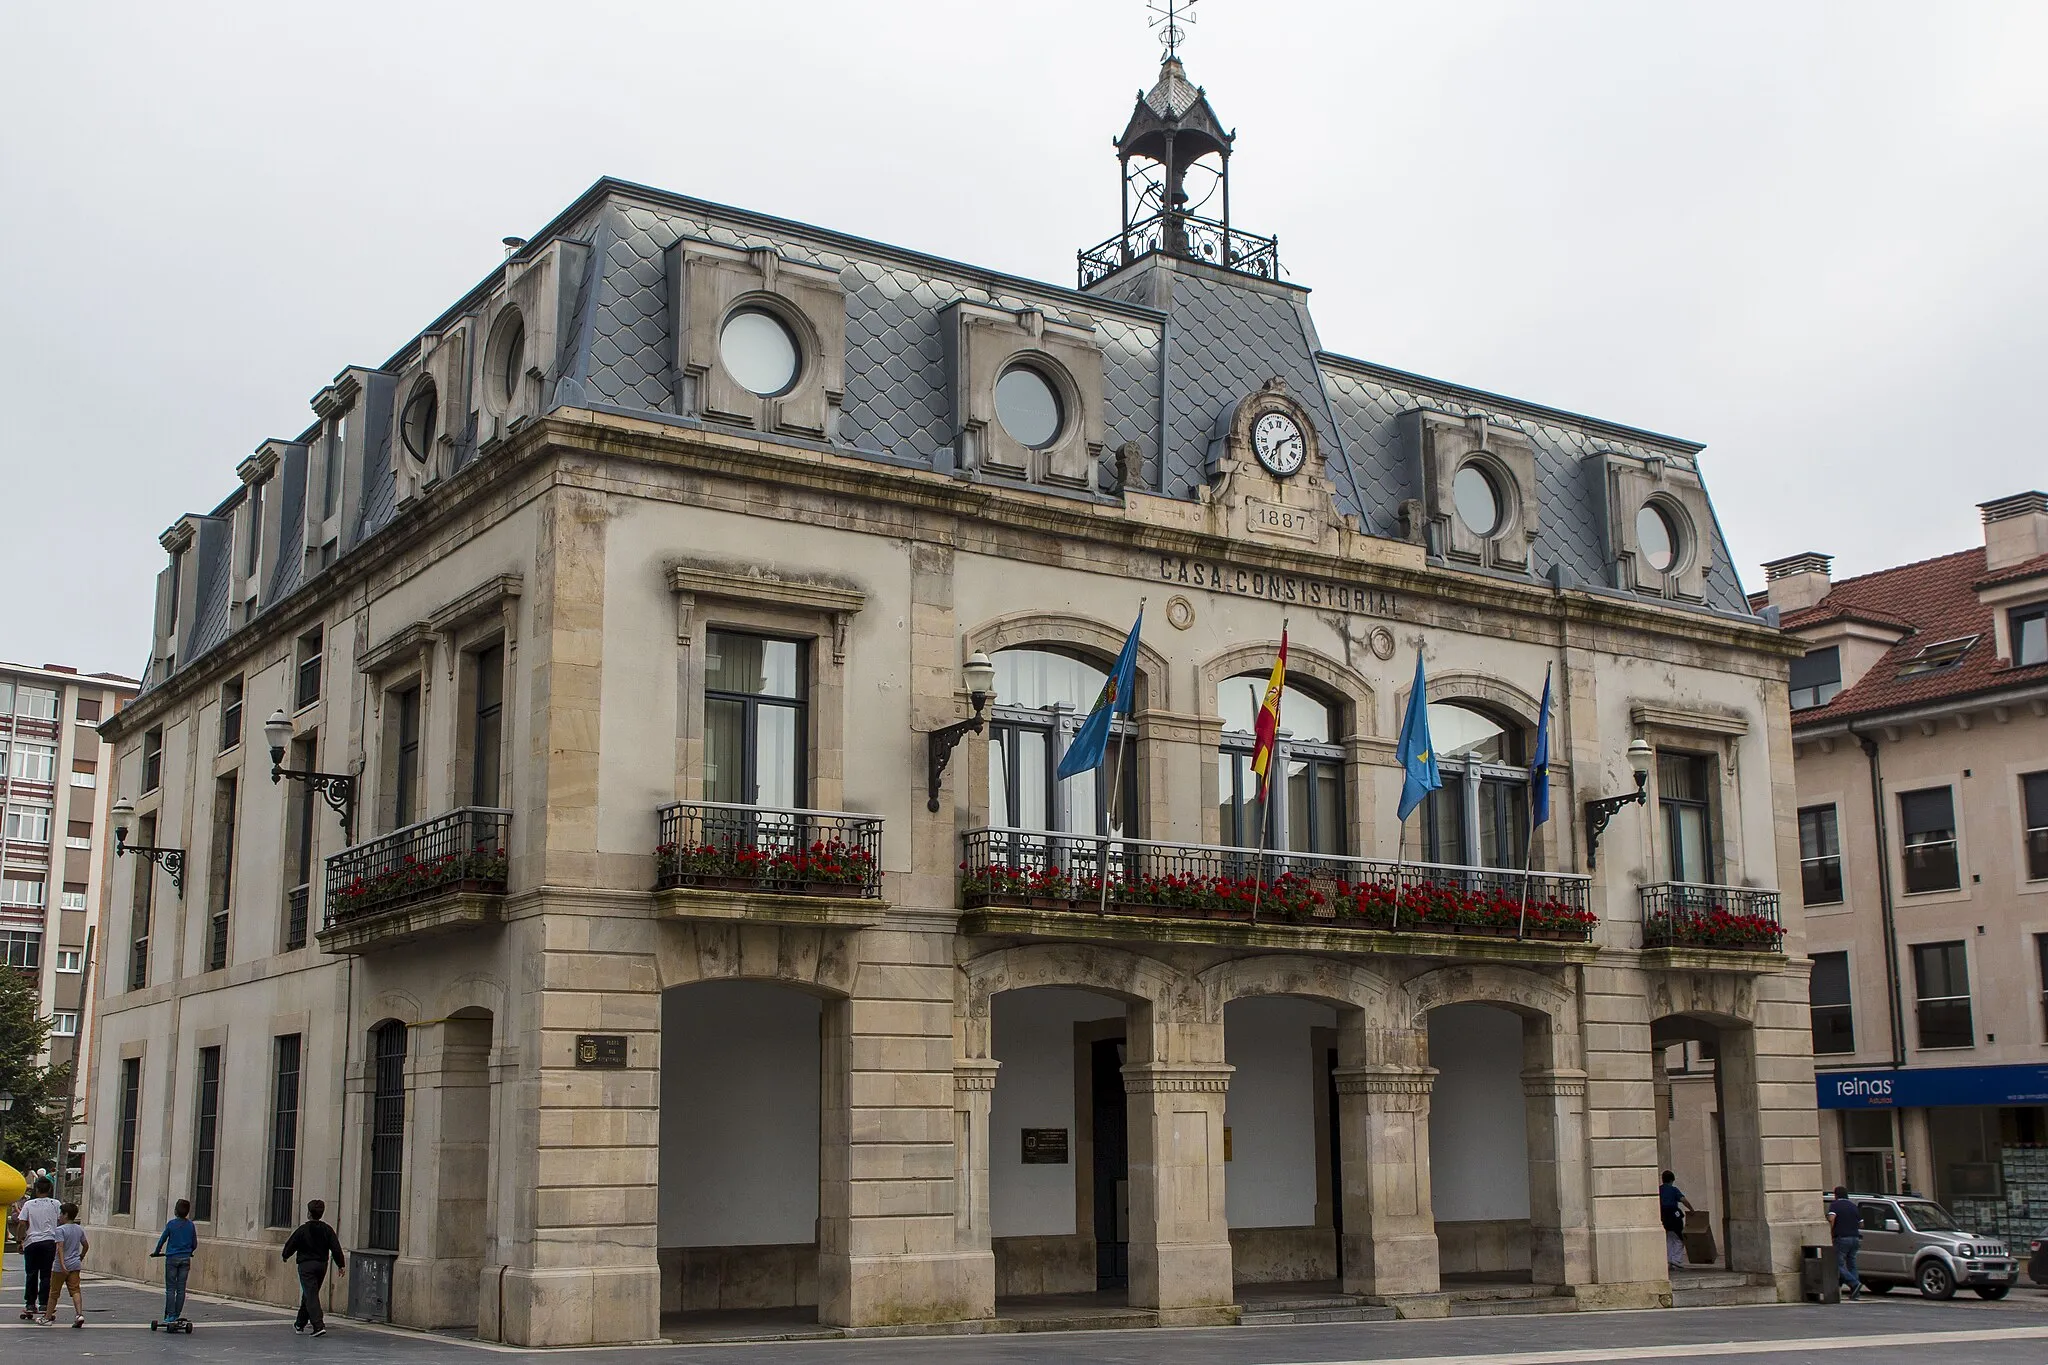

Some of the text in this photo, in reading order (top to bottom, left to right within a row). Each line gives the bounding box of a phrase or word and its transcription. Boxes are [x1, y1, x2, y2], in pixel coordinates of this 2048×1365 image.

[1259, 509, 1305, 530] 1887
[1160, 558, 1402, 616] CASA CONSISTORIAL
[1837, 1077, 1891, 1096] reinas
